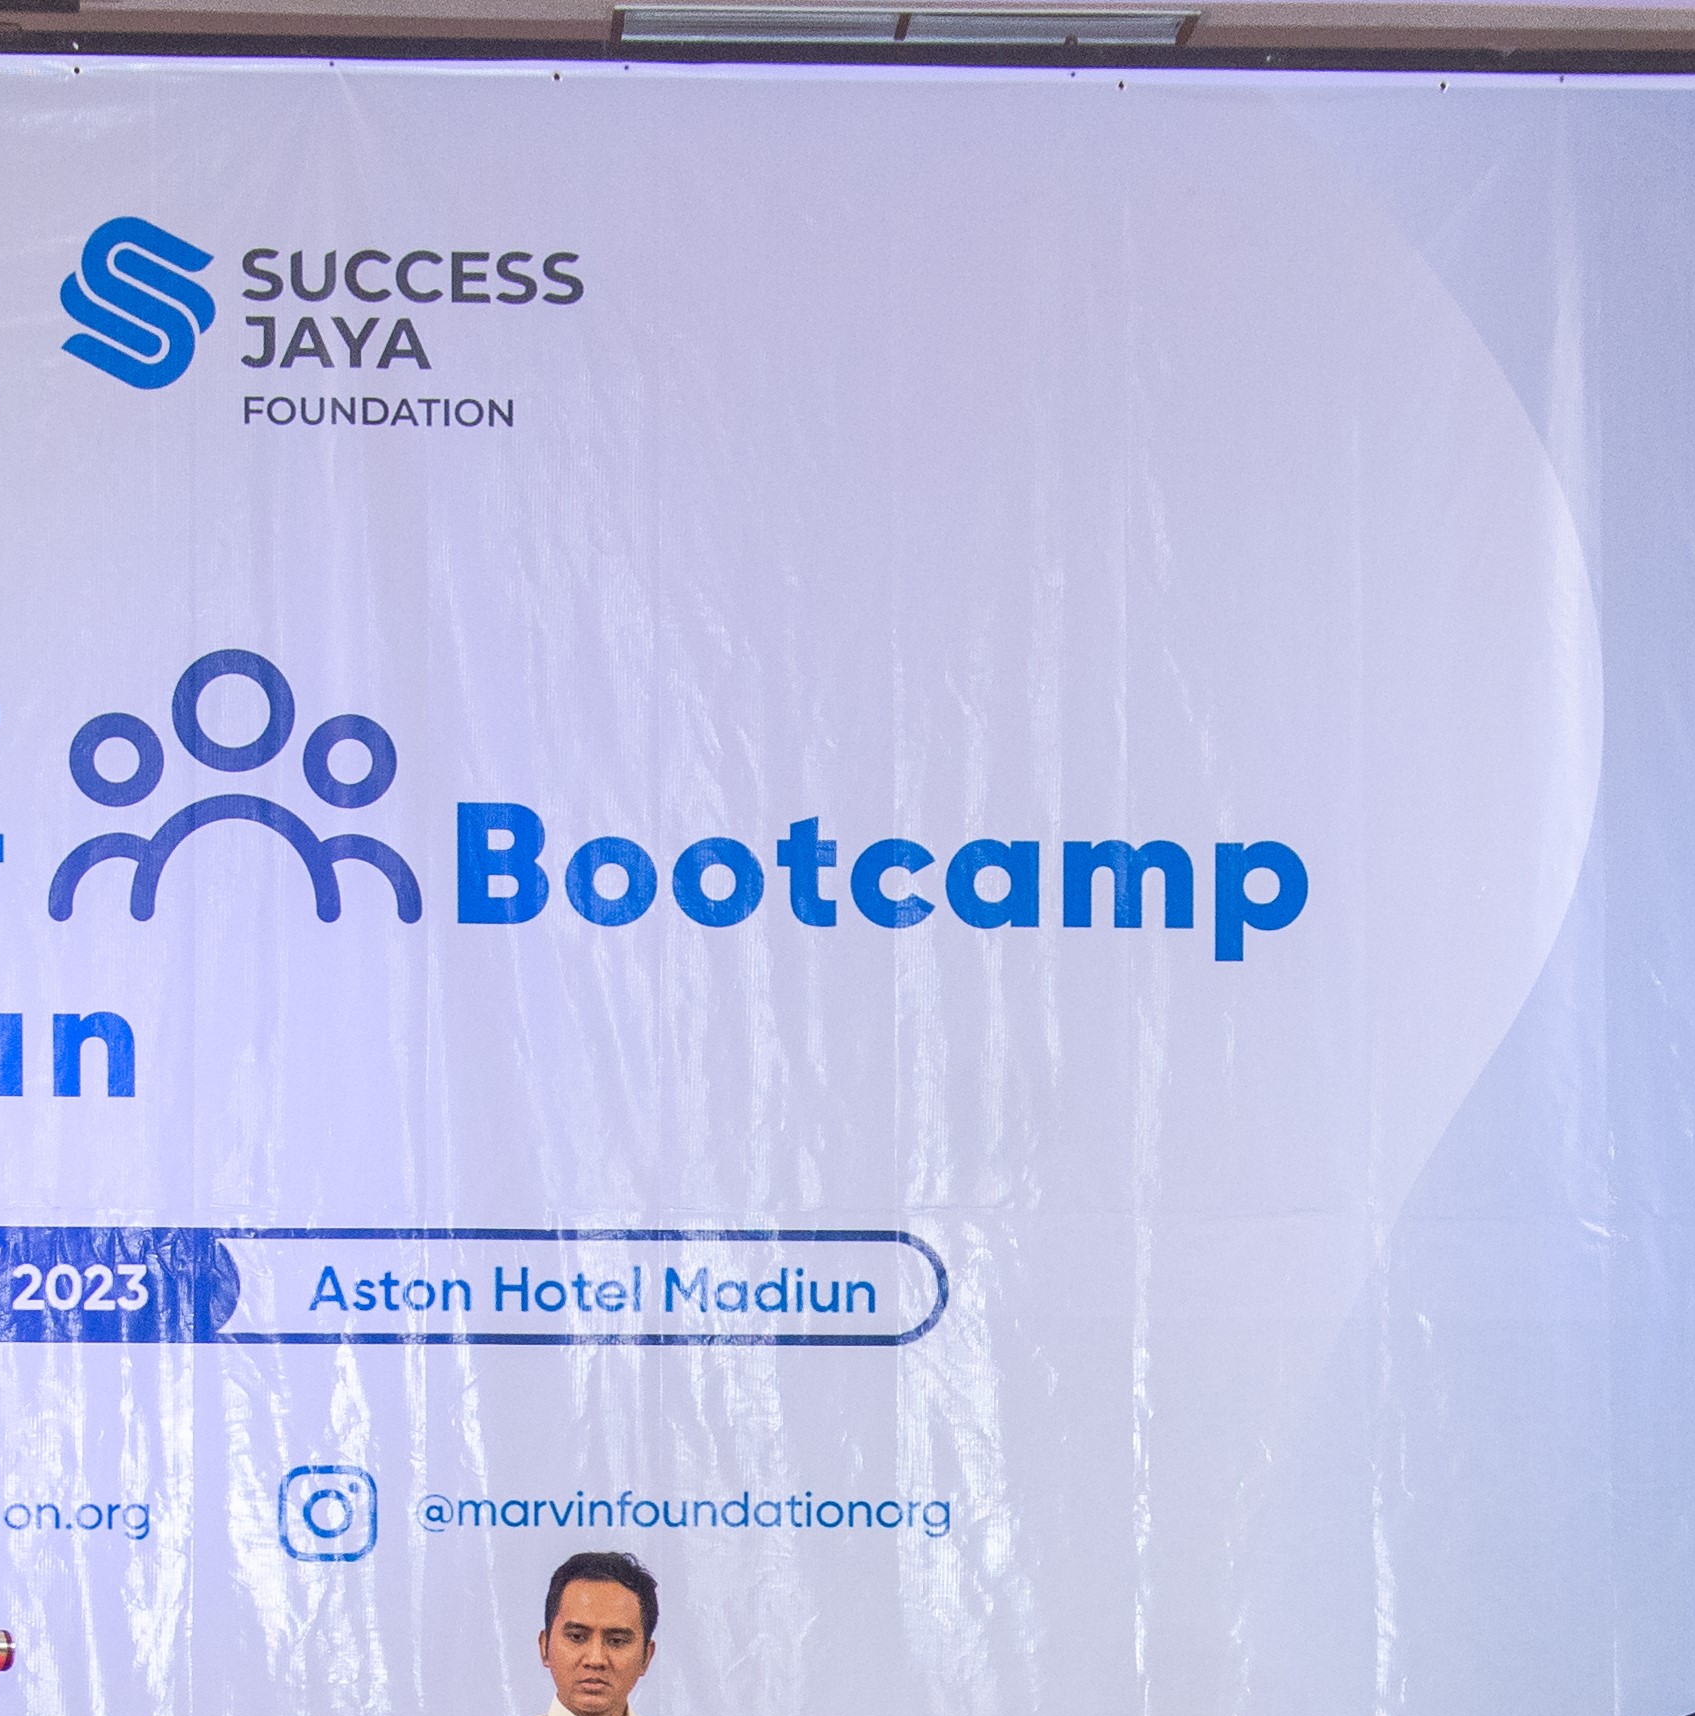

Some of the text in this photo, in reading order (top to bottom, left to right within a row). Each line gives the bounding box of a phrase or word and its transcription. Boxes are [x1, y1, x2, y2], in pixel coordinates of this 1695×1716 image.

[242, 248, 584, 306] SUCCESS
[241, 316, 432, 371] JAYA
[243, 396, 515, 429] FOUNDATION
[455, 801, 1309, 962] Bootcamp
[12, 1263, 150, 1312] 2023
[309, 1265, 877, 1314] Aston Hotel Madiun
[417, 1490, 952, 1538] @marvinfoundationorg
